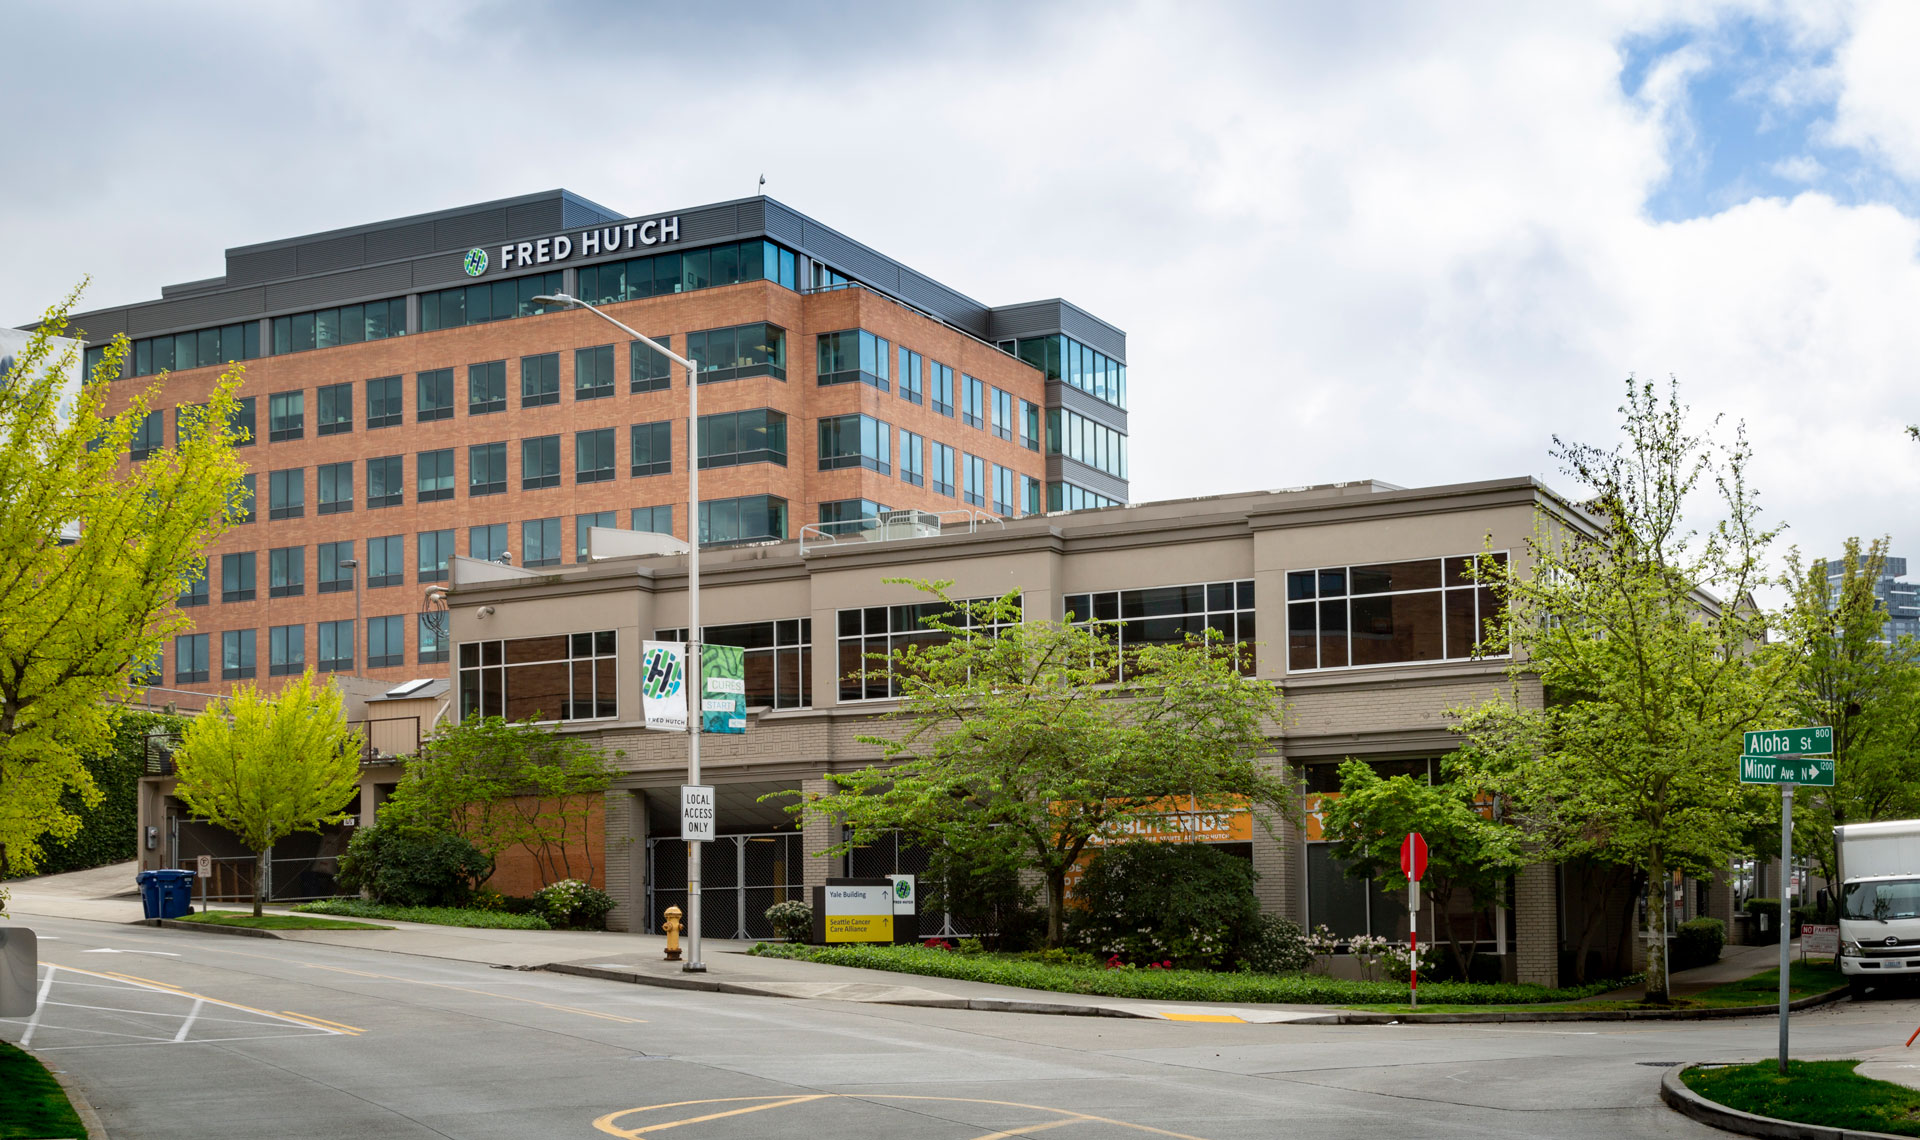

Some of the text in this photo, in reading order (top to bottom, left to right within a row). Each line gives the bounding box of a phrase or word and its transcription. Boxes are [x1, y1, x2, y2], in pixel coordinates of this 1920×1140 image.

[501, 216, 679, 269] FRED HUTCH
[712, 680, 741, 690] CURES
[706, 701, 731, 709] START
[665, 717, 685, 726] HUTCH
[1750, 729, 1829, 753] Aloha St 800
[1745, 758, 1832, 781] Minor Ave N 1200
[687, 794, 710, 805] LOCAL
[684, 808, 712, 819] ACCESS
[689, 822, 708, 832] ONLY
[843, 890, 867, 899] Building
[844, 925, 867, 933] Alliance
[1803, 926, 1813, 934] NO
